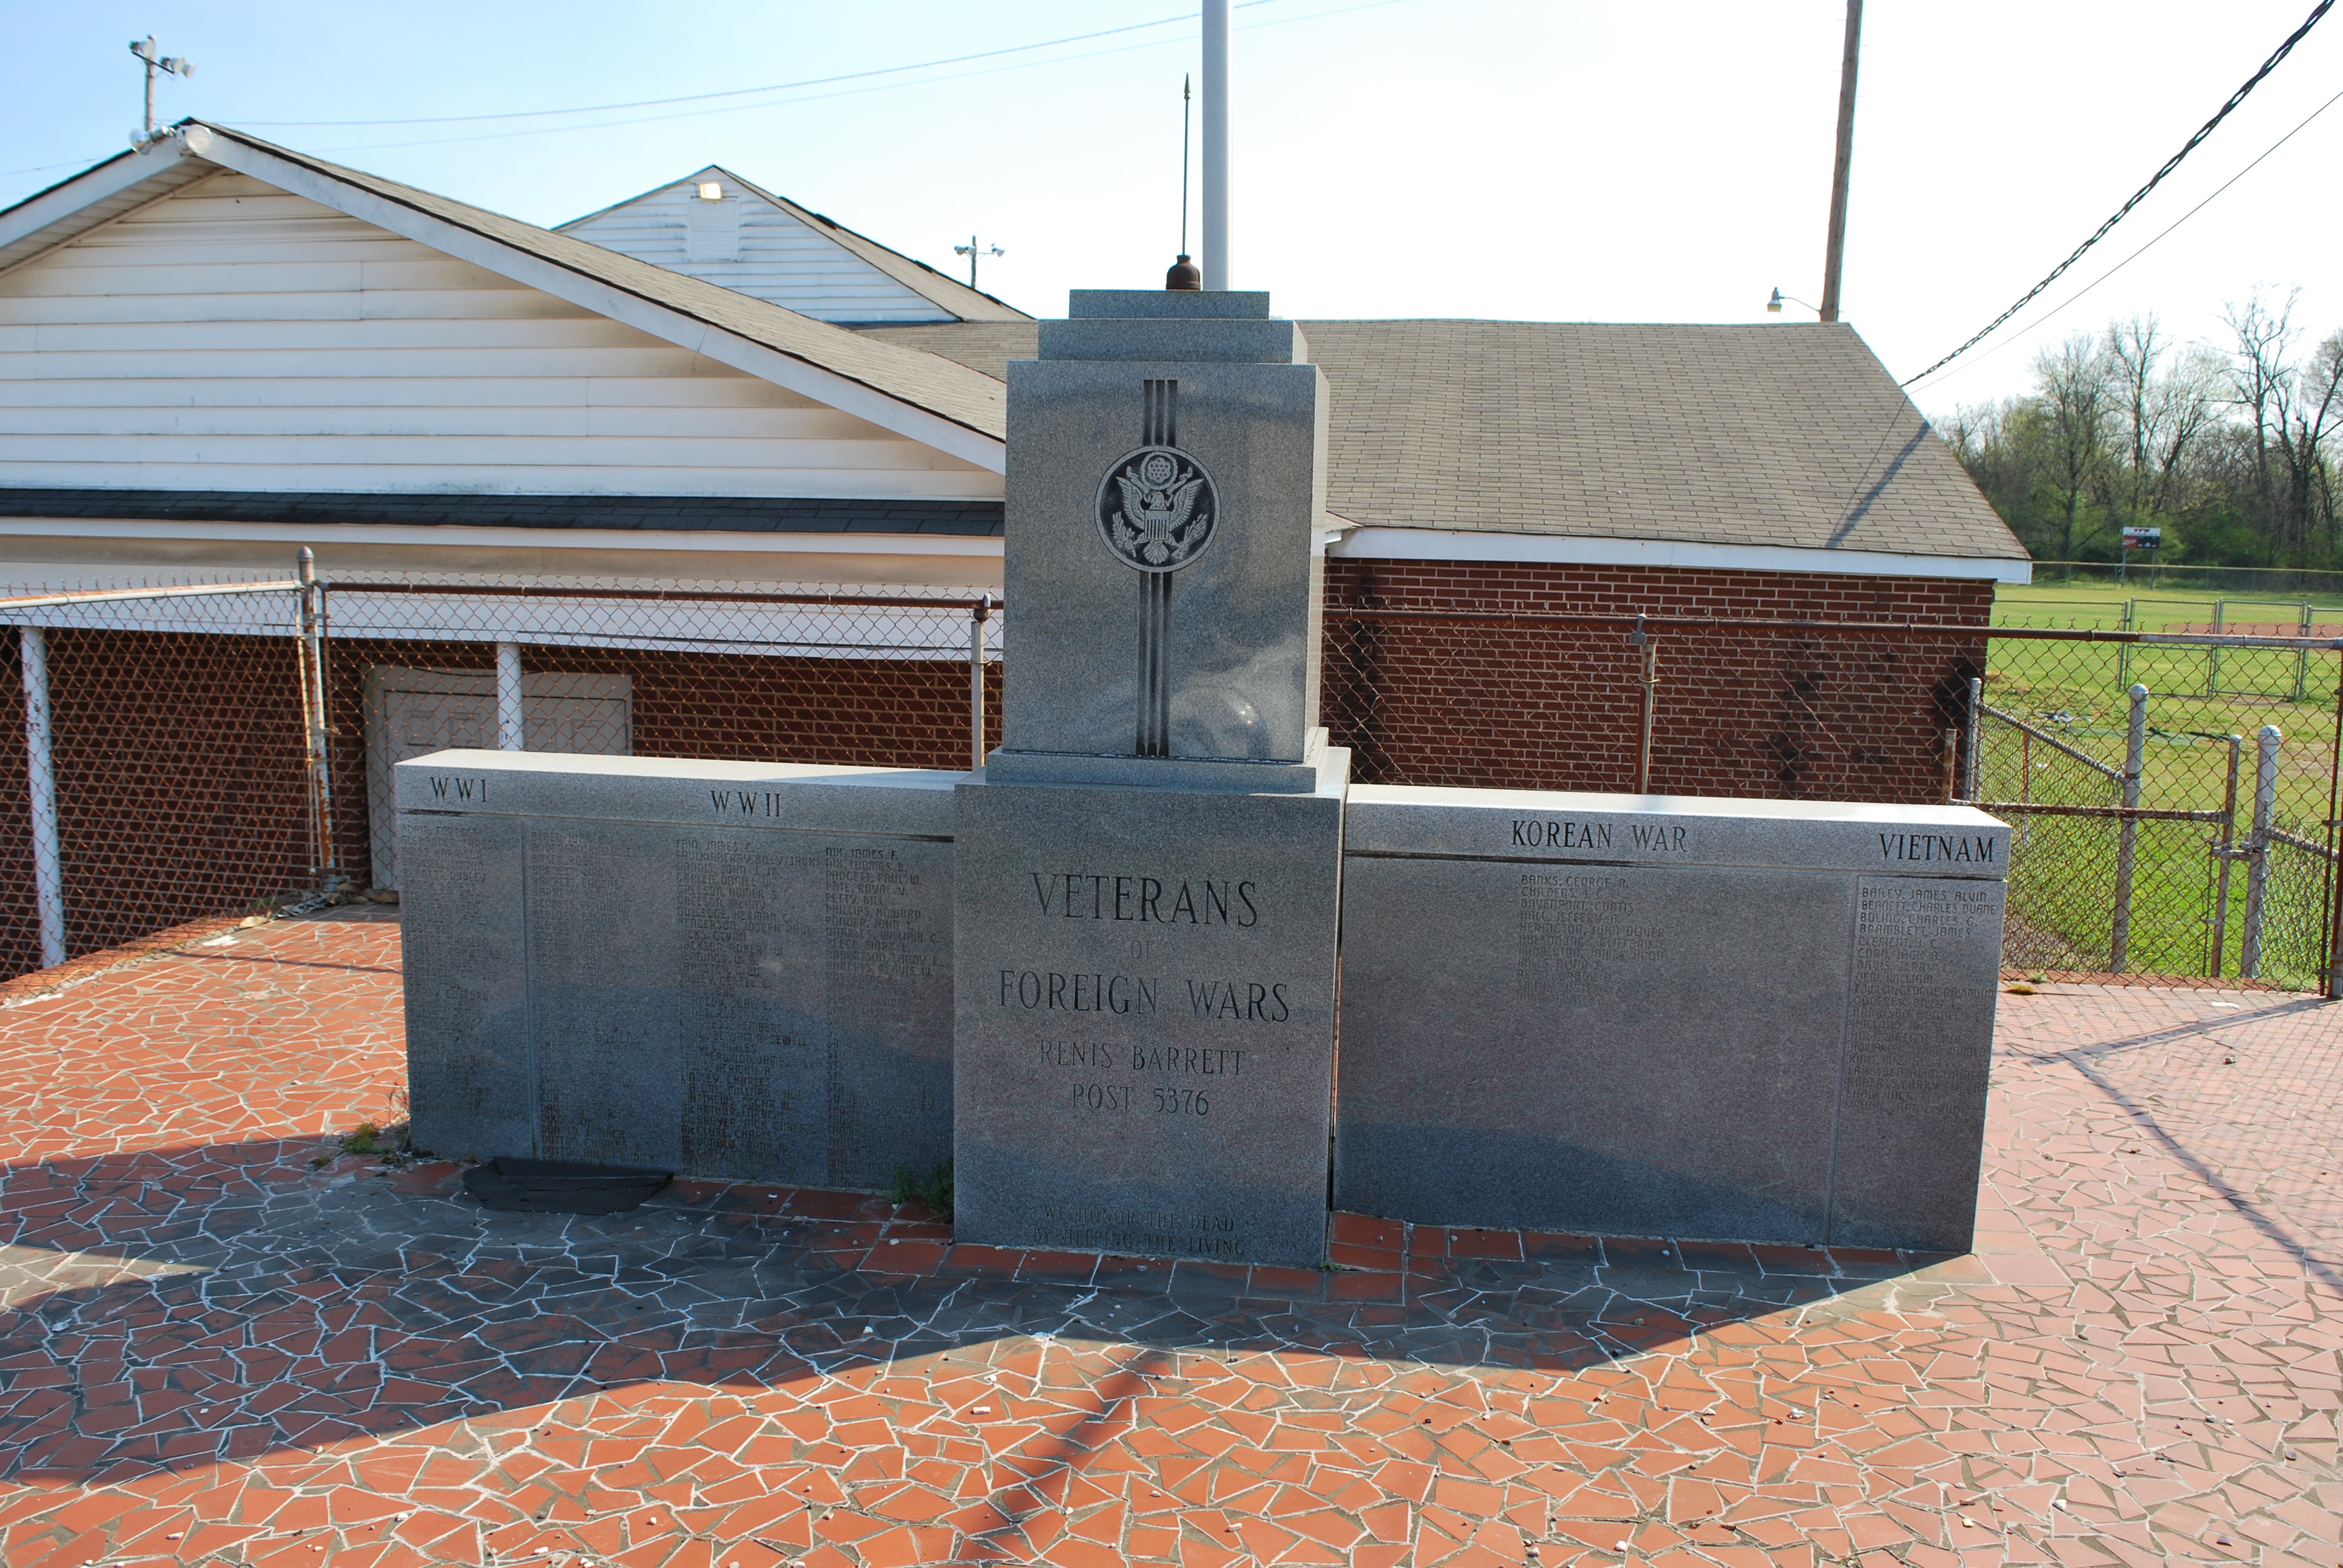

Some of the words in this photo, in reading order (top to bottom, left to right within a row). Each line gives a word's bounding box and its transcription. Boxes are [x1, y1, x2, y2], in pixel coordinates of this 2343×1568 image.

[430, 777, 487, 802] WWI
[710, 790, 781, 817] WWII
[1511, 820, 1612, 849] KOREAN
[1631, 825, 1687, 852] WAR
[706, 841, 738, 852] JAMES
[1879, 834, 1994, 863] VIETNAM
[756, 855, 782, 864] BILLY
[850, 849, 883, 859] JAMES
[851, 860, 891, 872] THOMAS
[877, 874, 903, 883] PAUL
[1566, 877, 1611, 887] GEORGE
[1619, 879, 1628, 888] R.
[729, 888, 764, 898] HOMER
[1910, 889, 1947, 901] JAMES
[1955, 891, 1987, 903] ALVIN
[864, 896, 883, 906] BILL
[1031, 872, 1259, 927] VETERANS
[1594, 901, 1633, 912] CURTIS
[1912, 902, 1957, 913] CHARLES
[1962, 904, 1996, 915] DUANE
[734, 911, 776, 921] HERMAN
[877, 908, 921, 920] HOWARD
[1556, 912, 1602, 923] JEFFERY
[874, 919, 899, 929] JOHN
[1909, 914, 1958, 926] CHARLES
[1967, 916, 1978, 927] G.
[743, 921, 780, 933] JOSEPH
[1591, 926, 1619, 935] JOHN
[1627, 926, 1665, 937] OLIVER
[1934, 926, 1970, 938] JAMES
[880, 930, 923, 942] WILLIAM
[1599, 938, 1651, 949] CLIFFORD
[1930, 939, 1940, 949] C.
[1131, 939, 1154, 961] OF
[1634, 950, 1663, 961] HUGH
[1895, 950, 1923, 960] JACK
[1556, 959, 1588, 969] ALVIN
[1899, 961, 1936, 972] JERRY
[1559, 971, 1596, 982] GRADY
[1887, 974, 1933, 984] WILLIAM
[998, 970, 1158, 1015] FOREIGN
[1187, 979, 1291, 1023] WARS
[1899, 985, 1939, 996] GEORGE
[1944, 987, 1995, 998] RAYMOND
[1913, 998, 1944, 1008] BILLY
[771, 1035, 807, 1046] SEWELL
[712, 1043, 756, 1054] CHARLES
[758, 1056, 790, 1067] JAMES
[1040, 1039, 1112, 1069] RENIS
[1133, 1046, 1245, 1076] BARRETT
[716, 1063, 756, 1076] HERMAN
[727, 1075, 771, 1087] CHARLES
[742, 1097, 775, 1109] OSCAR
[1072, 1084, 1134, 1111] POST
[1153, 1089, 1210, 1116] 5376
[742, 1108, 783, 1119] FARRISH
[744, 1119, 767, 1129] JACK
[735, 1129, 779, 1141] CHARLES
[741, 1141, 772, 1151] FRANK
[1043, 1205, 1066, 1222] WE
[1078, 1207, 1135, 1226] HONOR
[1149, 1212, 1177, 1229] THE
[1190, 1214, 1234, 1232] DEAD
[1033, 1227, 1050, 1243] BY
[1064, 1230, 1133, 1248] HELPING
[1145, 1234, 1175, 1250] THE
[1189, 1238, 1244, 1256] LIVING
